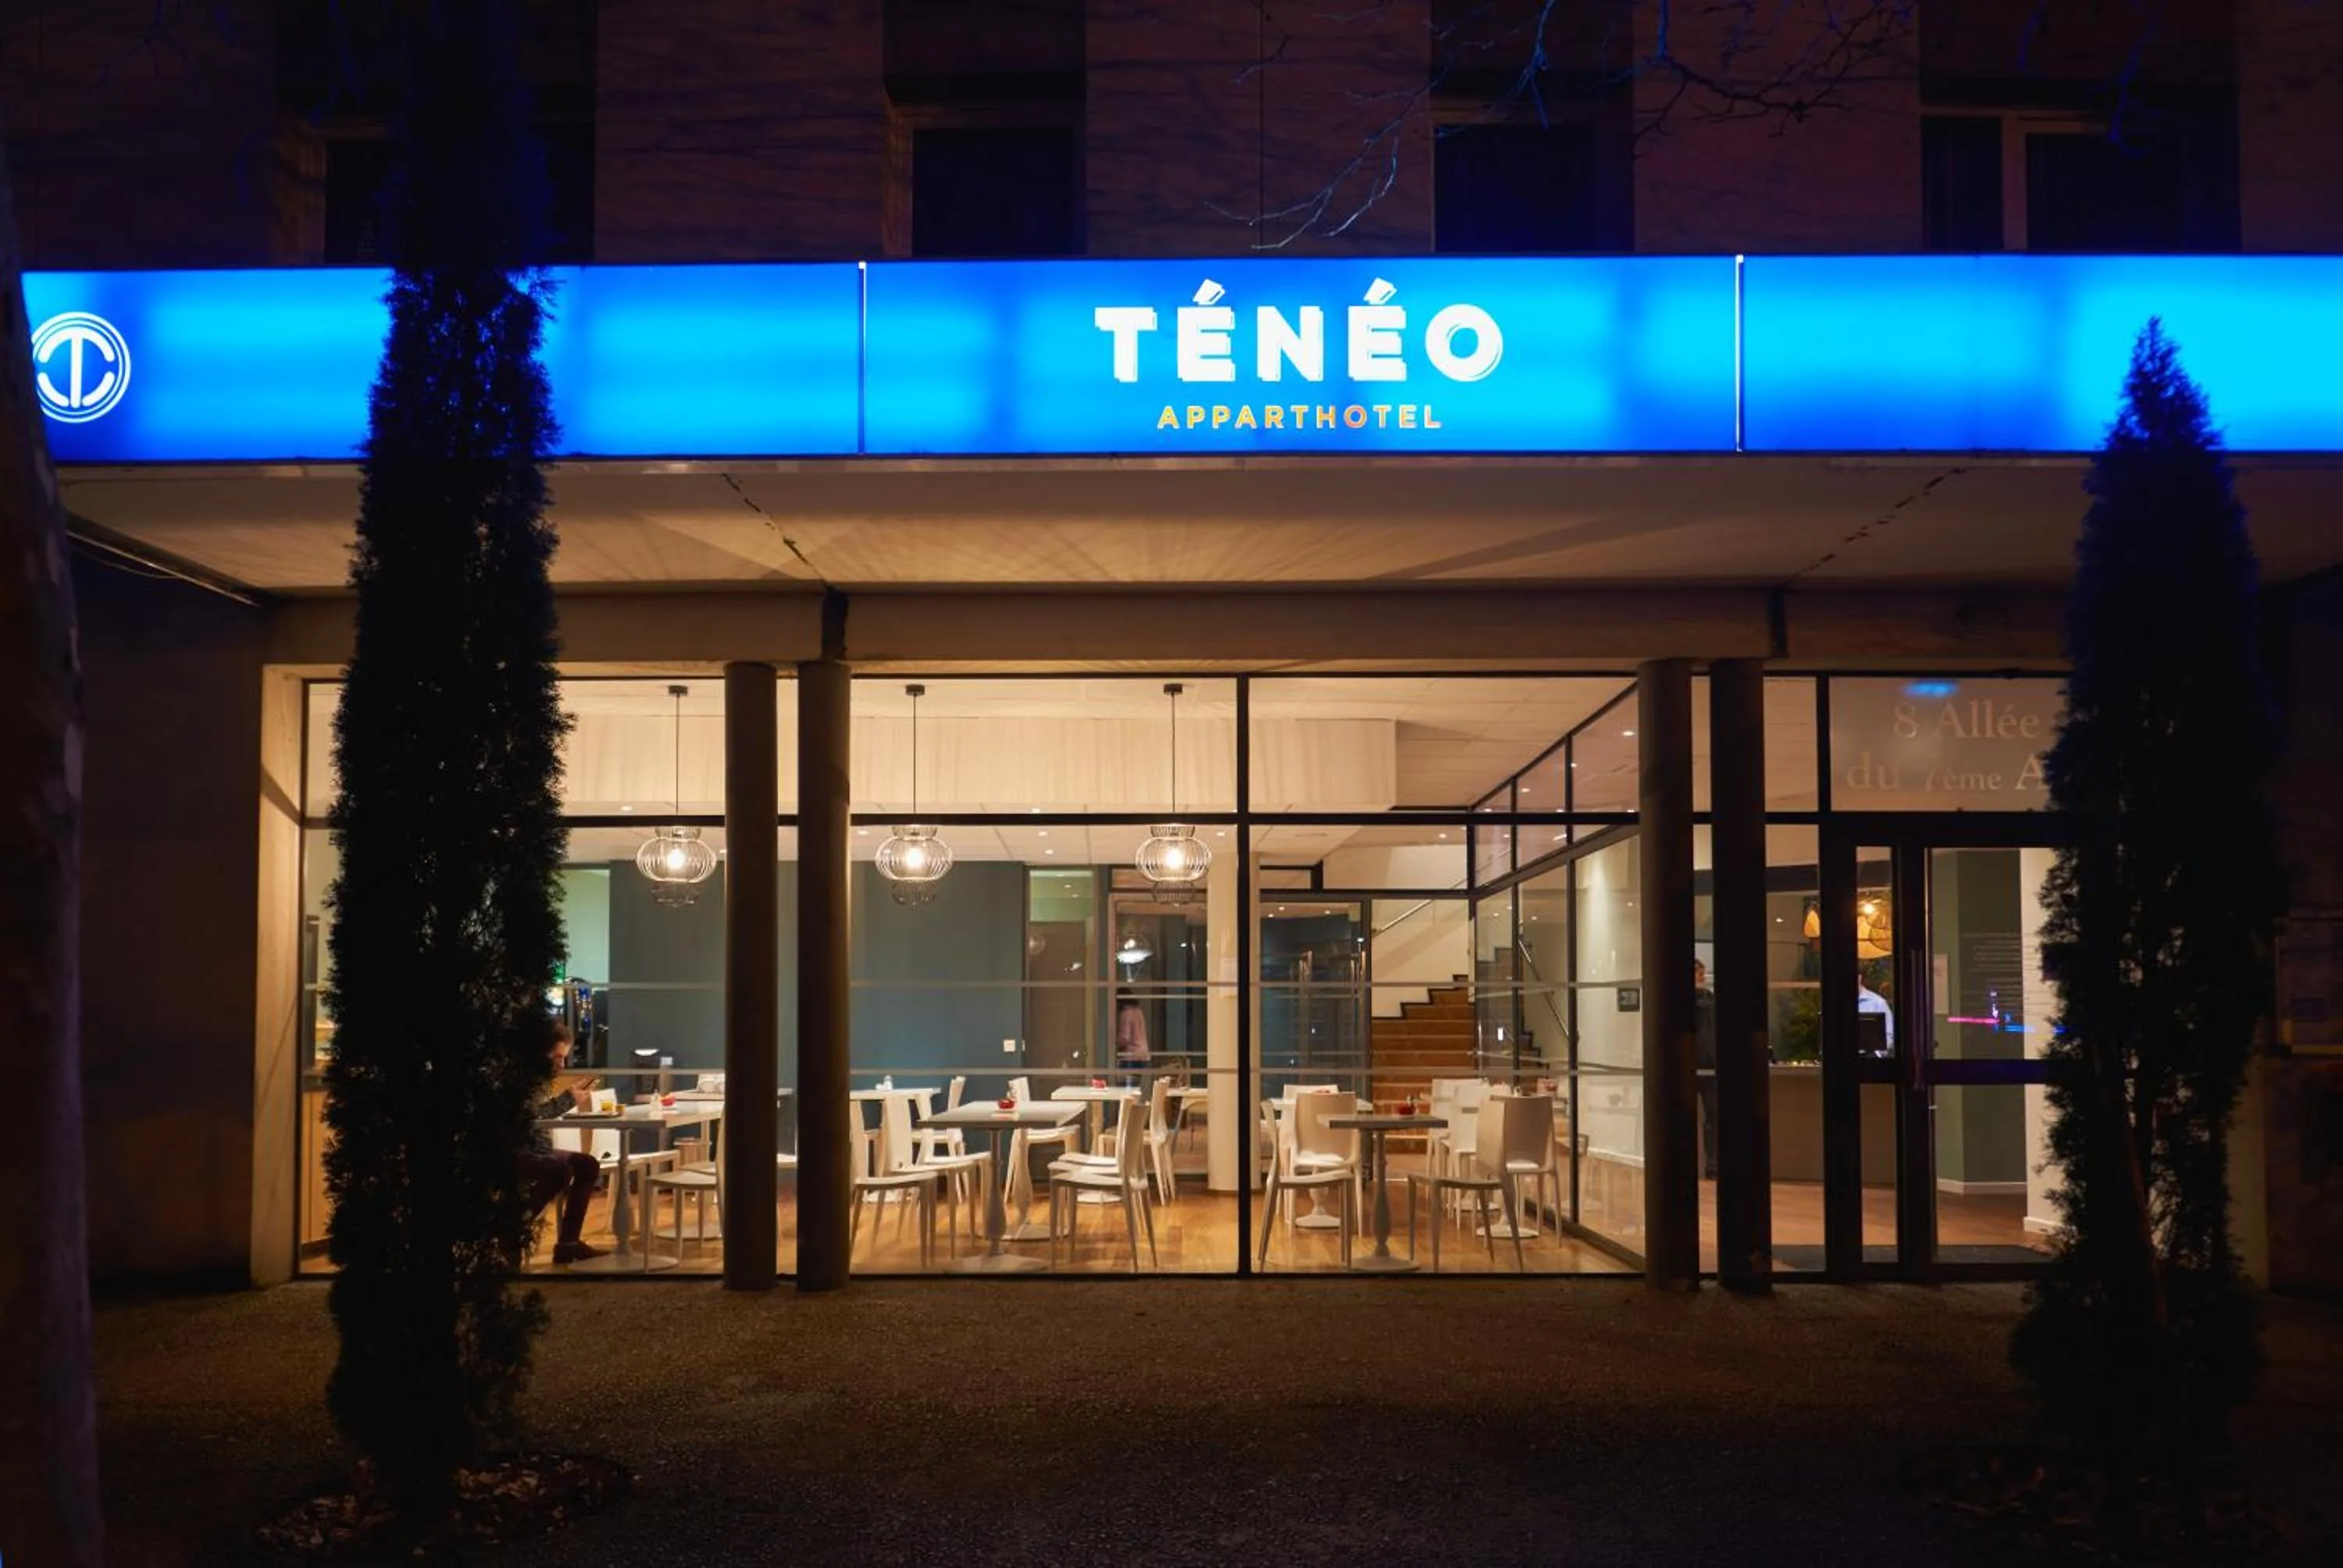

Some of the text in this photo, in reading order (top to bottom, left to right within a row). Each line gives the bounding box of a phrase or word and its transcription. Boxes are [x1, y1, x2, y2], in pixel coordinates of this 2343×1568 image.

[1094, 277, 1503, 383] TÉNÉO
[1156, 404, 1443, 429] APPARTHOTEL
[1892, 698, 2042, 739] 8 Allée
[1846, 750, 1901, 790] du
